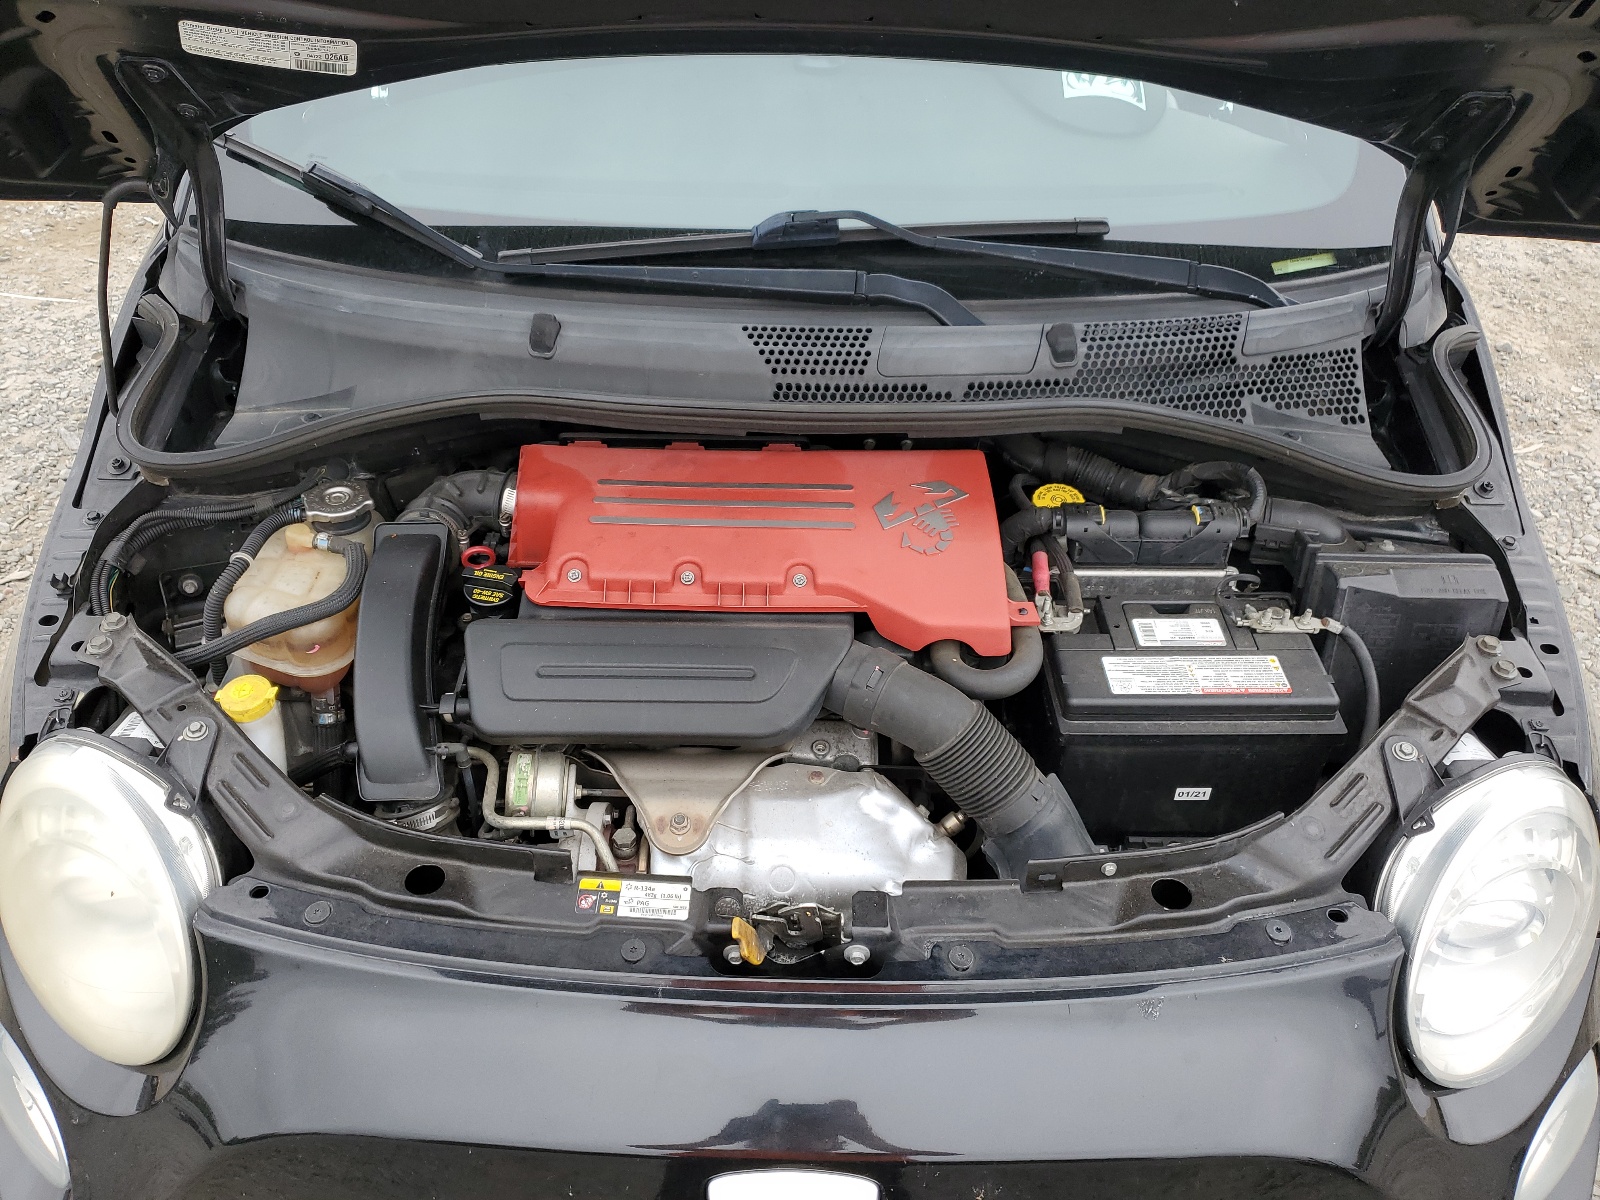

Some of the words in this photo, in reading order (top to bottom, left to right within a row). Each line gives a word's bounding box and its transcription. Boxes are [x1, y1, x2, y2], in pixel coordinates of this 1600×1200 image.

[314, 38, 349, 46] INFORMATION
[472, 594, 499, 602] SYNTHETIC
[1177, 790, 1207, 798] 01/21
